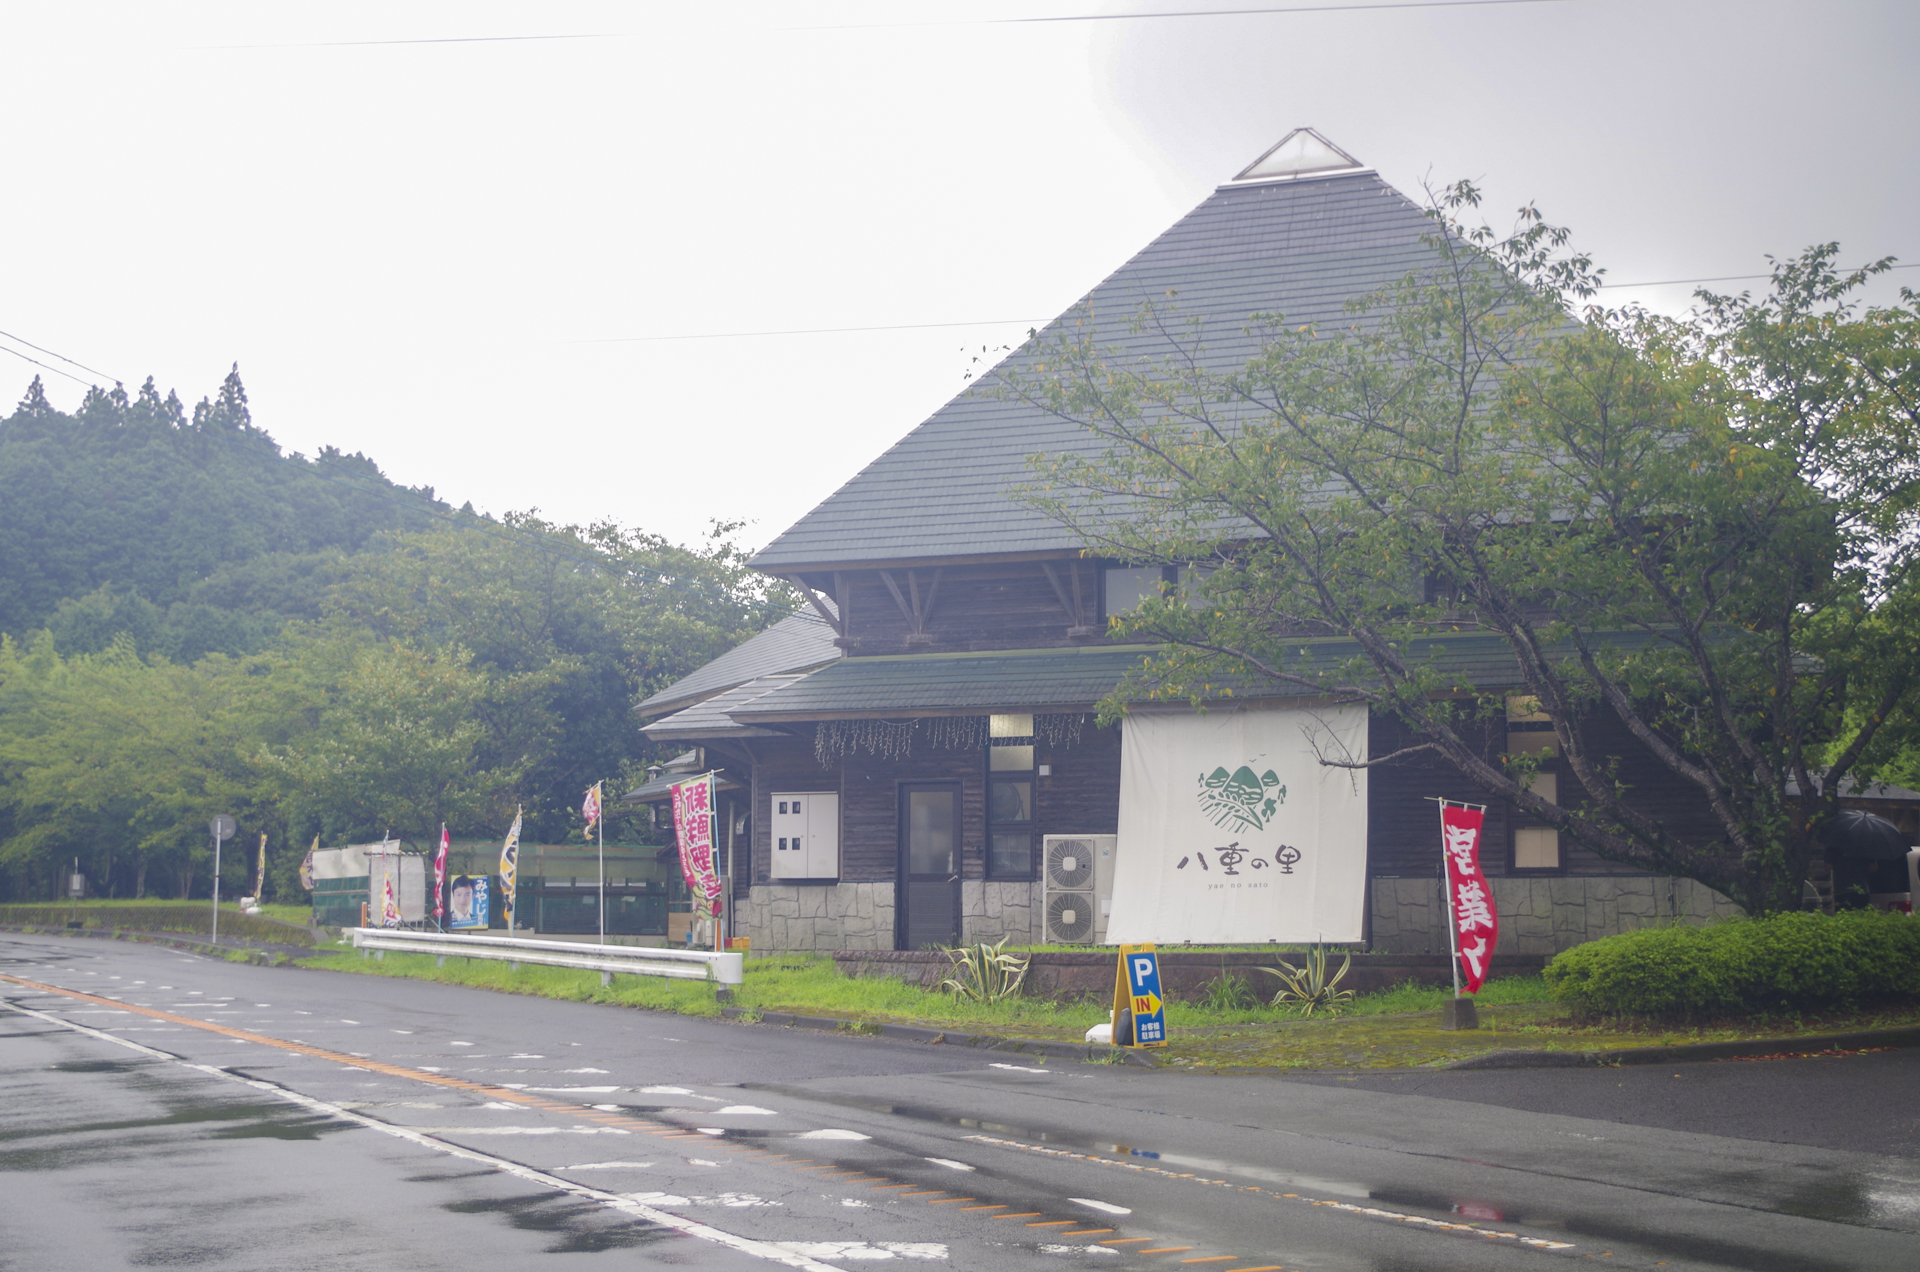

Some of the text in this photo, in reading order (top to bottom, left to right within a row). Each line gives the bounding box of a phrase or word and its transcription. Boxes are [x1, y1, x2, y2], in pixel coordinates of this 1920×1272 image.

[1176, 841, 1302, 876] 八重の里
[1207, 882, 1225, 890] yae
[1247, 881, 1269, 889] sato
[475, 879, 488, 915] みやじ
[1134, 958, 1153, 986] P
[1135, 997, 1151, 1012] IN
[1141, 1021, 1160, 1031] お客様
[1141, 1031, 1161, 1040] 駐車場
